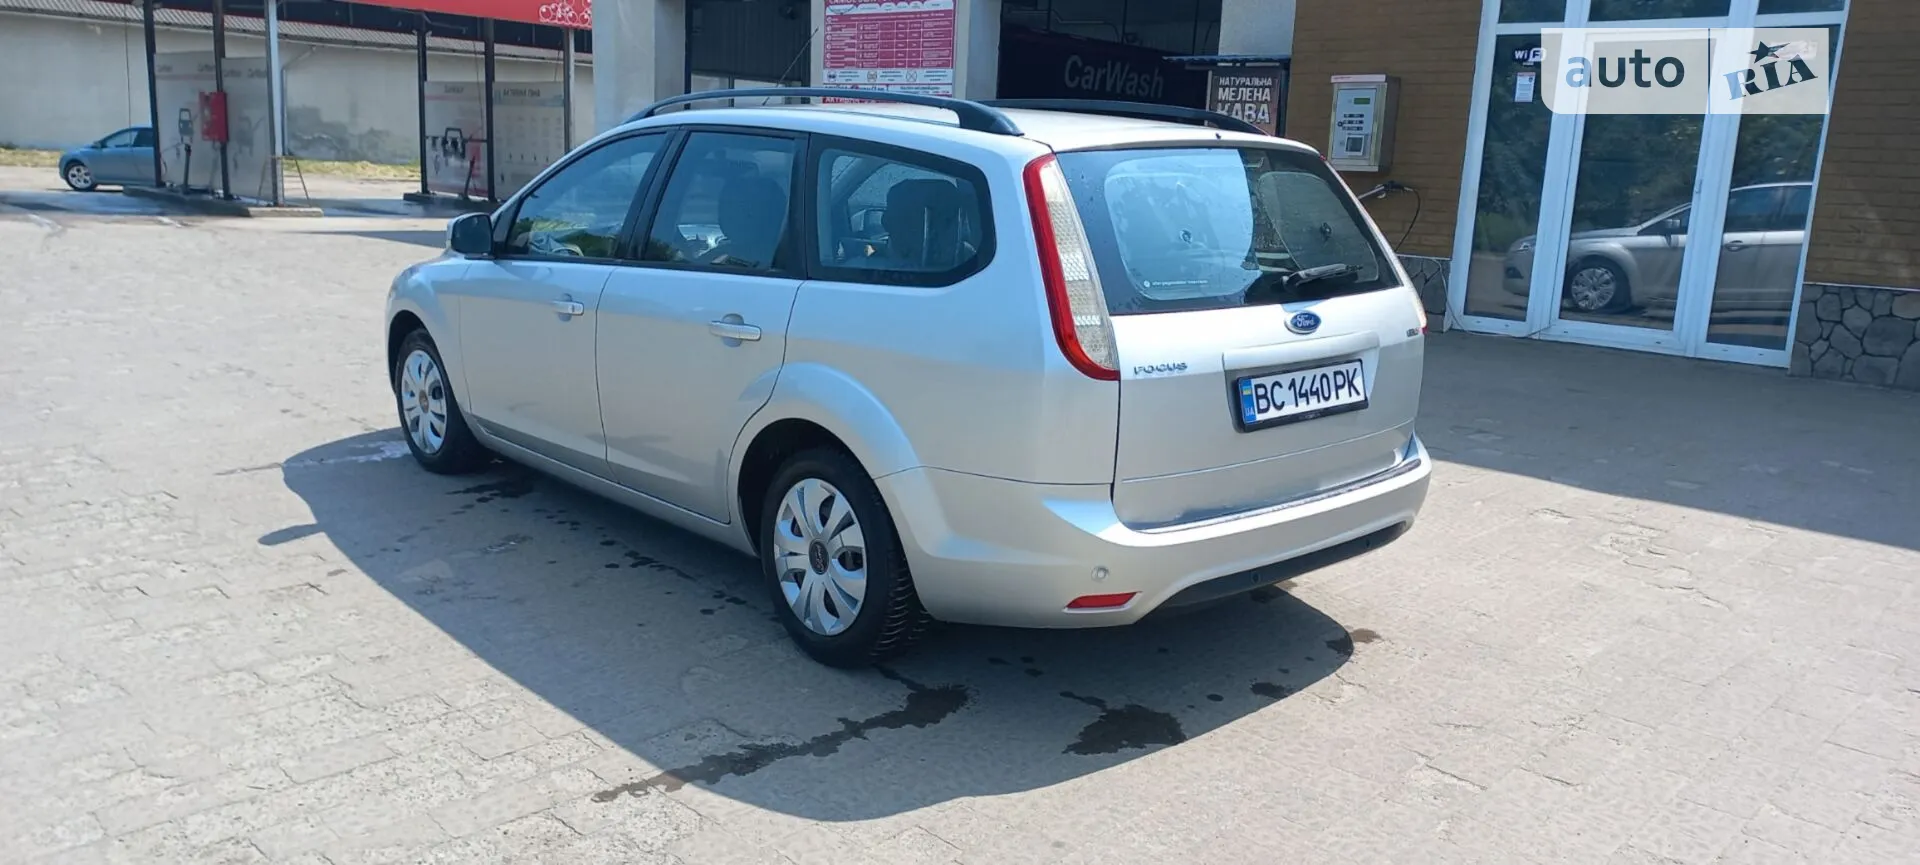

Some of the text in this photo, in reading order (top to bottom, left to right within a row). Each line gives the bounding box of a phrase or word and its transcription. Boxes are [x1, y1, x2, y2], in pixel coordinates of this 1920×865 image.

[1064, 55, 1164, 98] CarWash
[1219, 76, 1273, 86] НАТУРАЛЬНА
[1218, 87, 1272, 102] МЕЛЕНА
[1216, 102, 1271, 123] КАВА
[1133, 362, 1188, 375] FOCUS
[1245, 407, 1255, 417] UA
